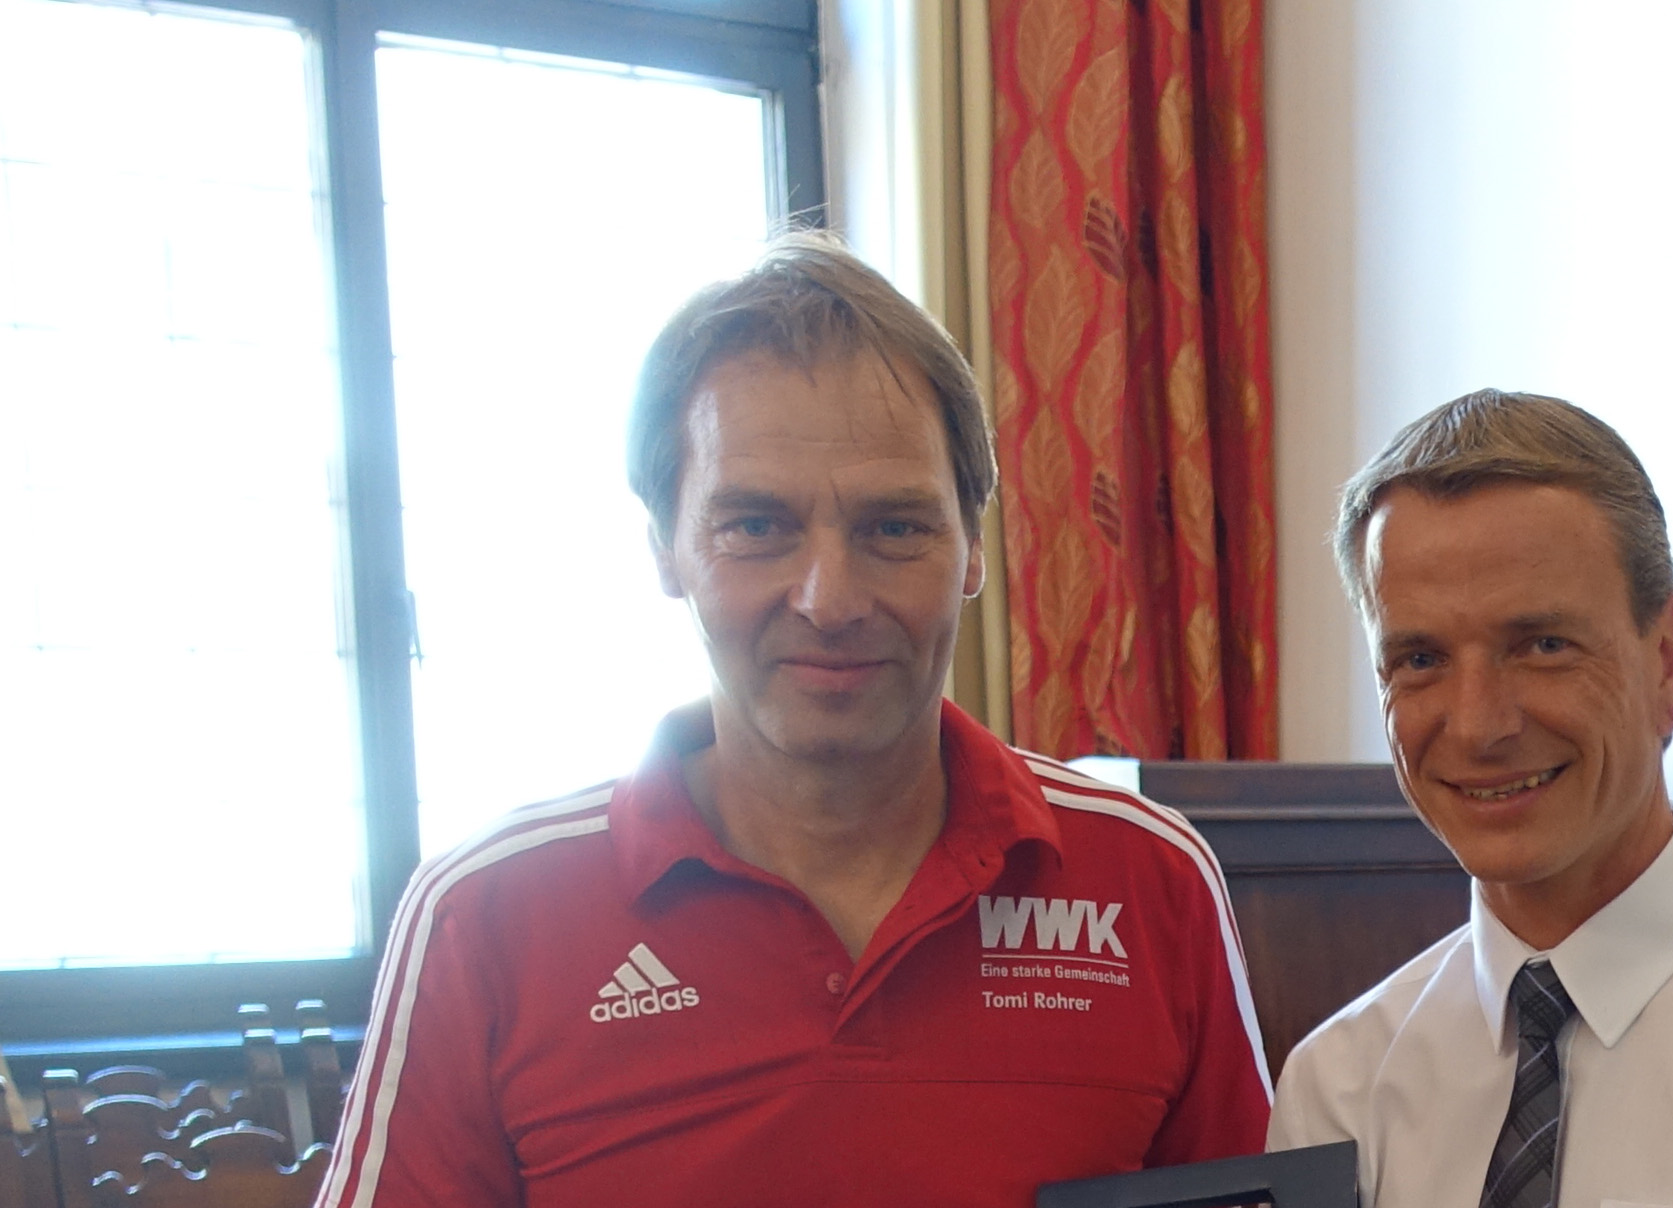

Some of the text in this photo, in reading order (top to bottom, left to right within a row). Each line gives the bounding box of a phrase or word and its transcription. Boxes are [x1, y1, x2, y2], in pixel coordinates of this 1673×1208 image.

[978, 895, 1129, 959] WWK
[981, 963, 1130, 987] Eine starke Gemeinschaft
[590, 987, 700, 1022] adidas
[982, 992, 1093, 1012] Tomi Rohrer
